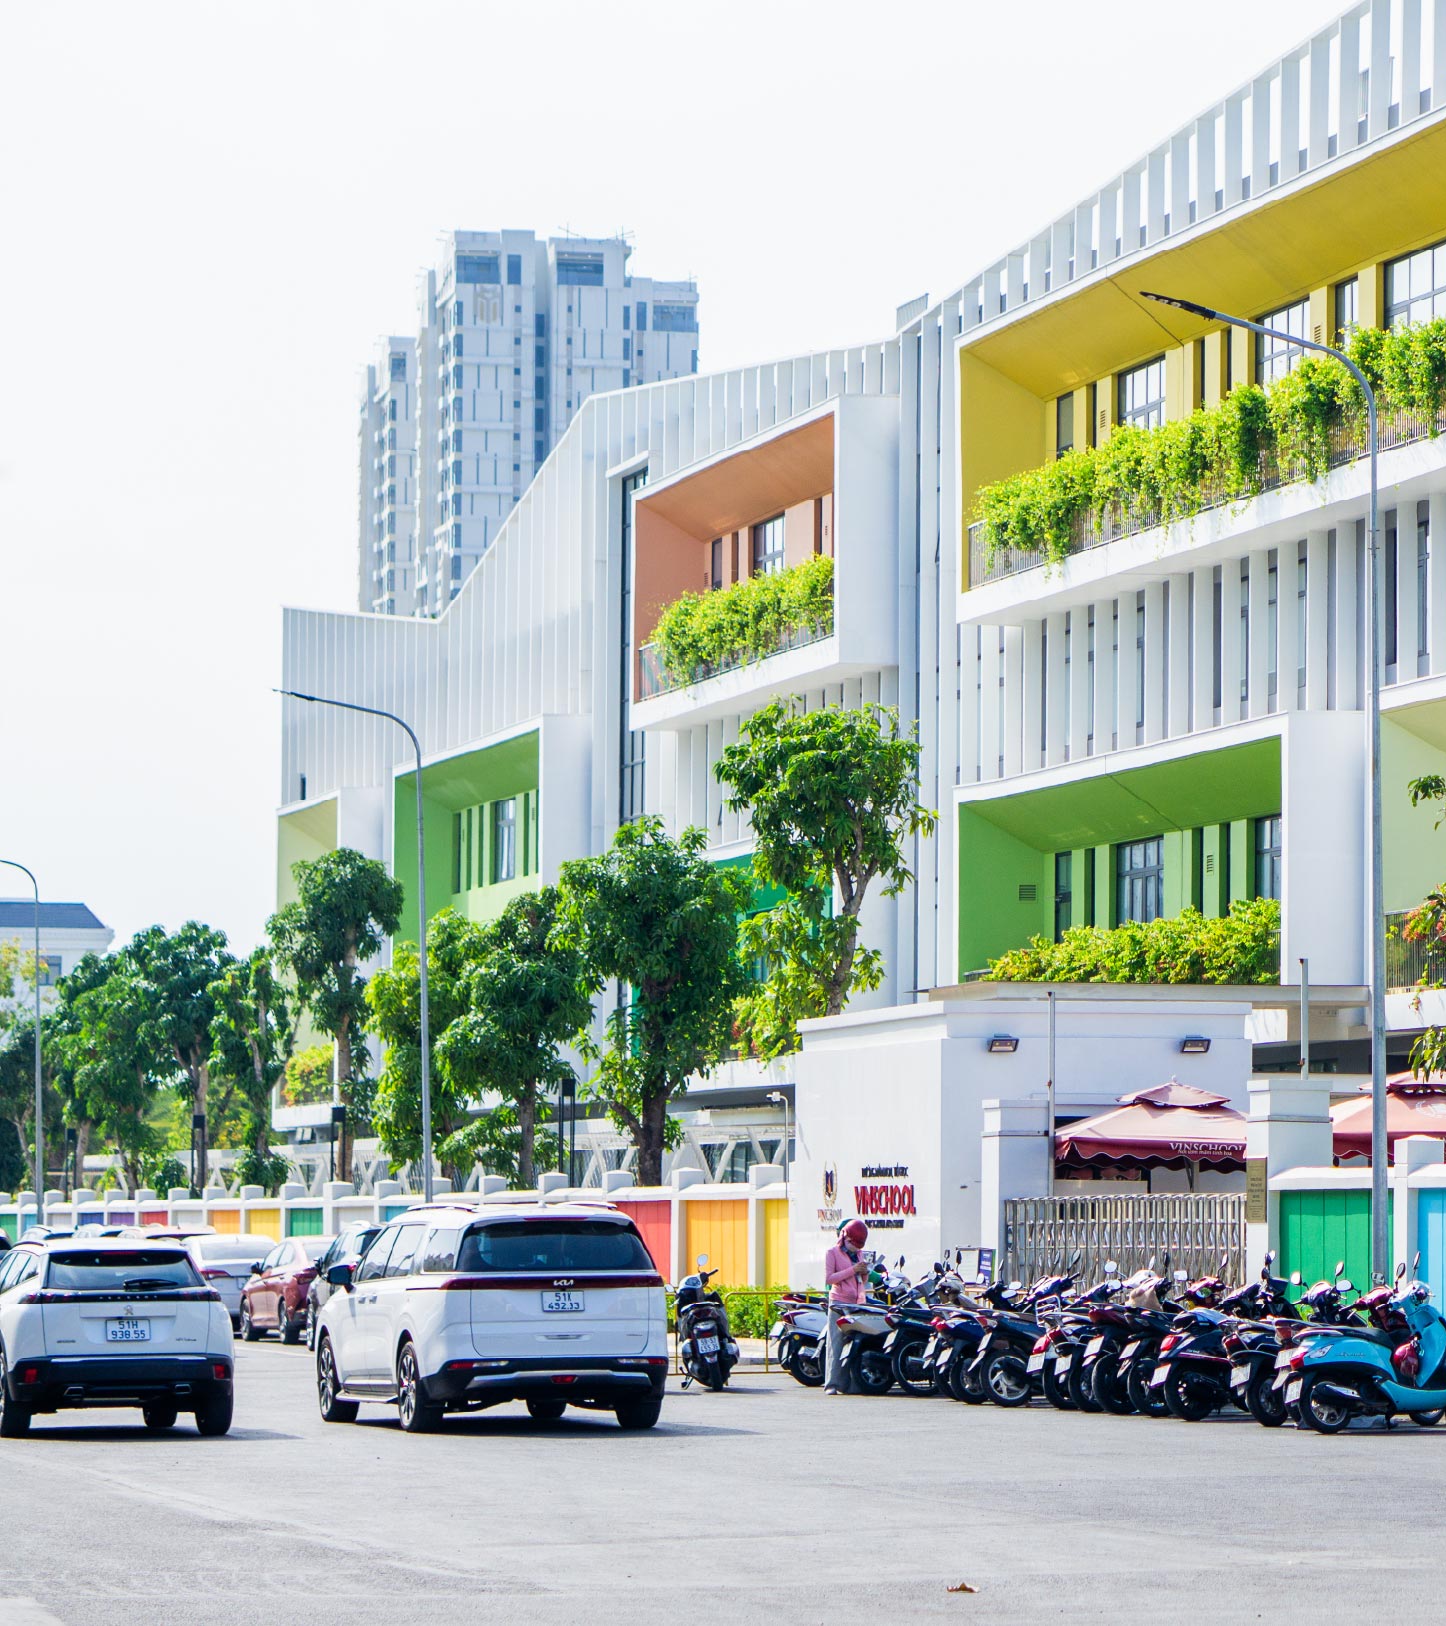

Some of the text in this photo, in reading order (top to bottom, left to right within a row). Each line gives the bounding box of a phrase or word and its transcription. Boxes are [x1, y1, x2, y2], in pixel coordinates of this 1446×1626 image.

[854, 1185, 917, 1215] VINSCHOOL
[118, 1321, 139, 1330] 51H
[111, 1330, 146, 1339] 938.55
